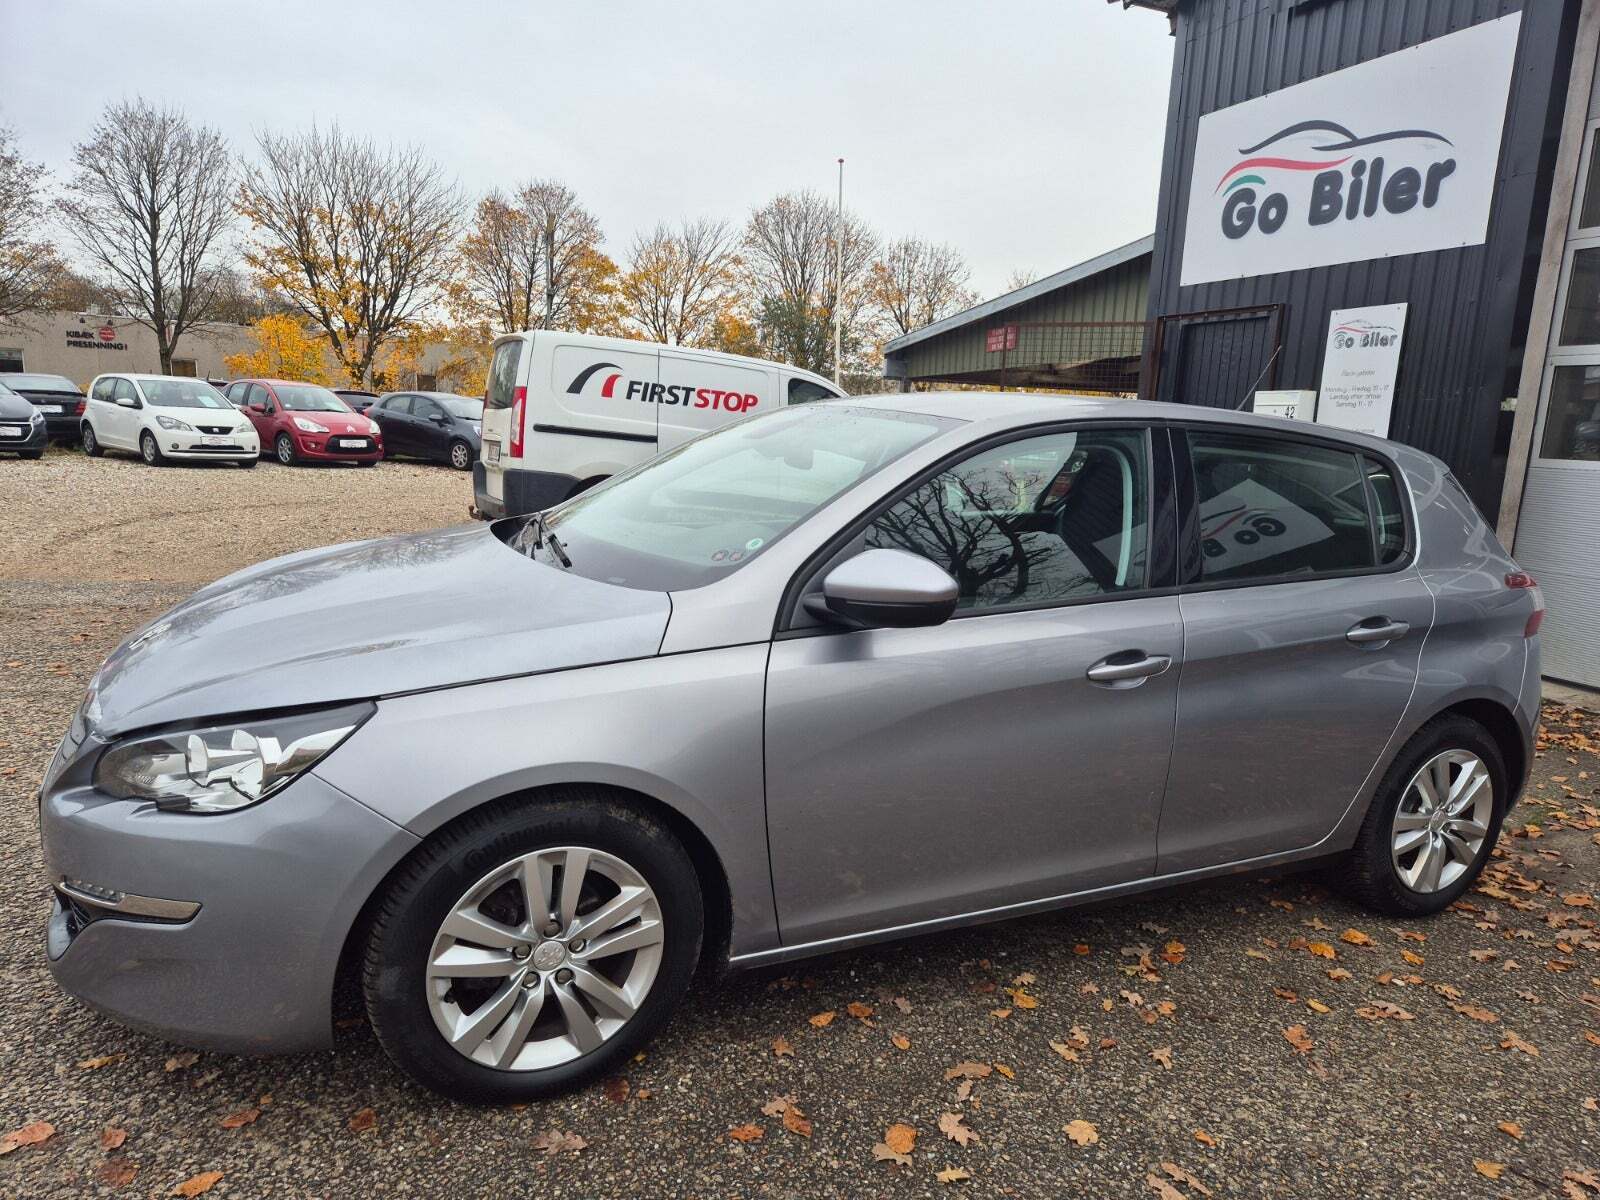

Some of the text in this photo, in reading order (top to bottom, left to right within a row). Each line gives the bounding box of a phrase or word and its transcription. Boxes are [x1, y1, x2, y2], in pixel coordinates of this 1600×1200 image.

[1221, 156, 1457, 239] Go Biler
[1334, 331, 1398, 349] Go Biler
[1284, 406, 1295, 418] 42
